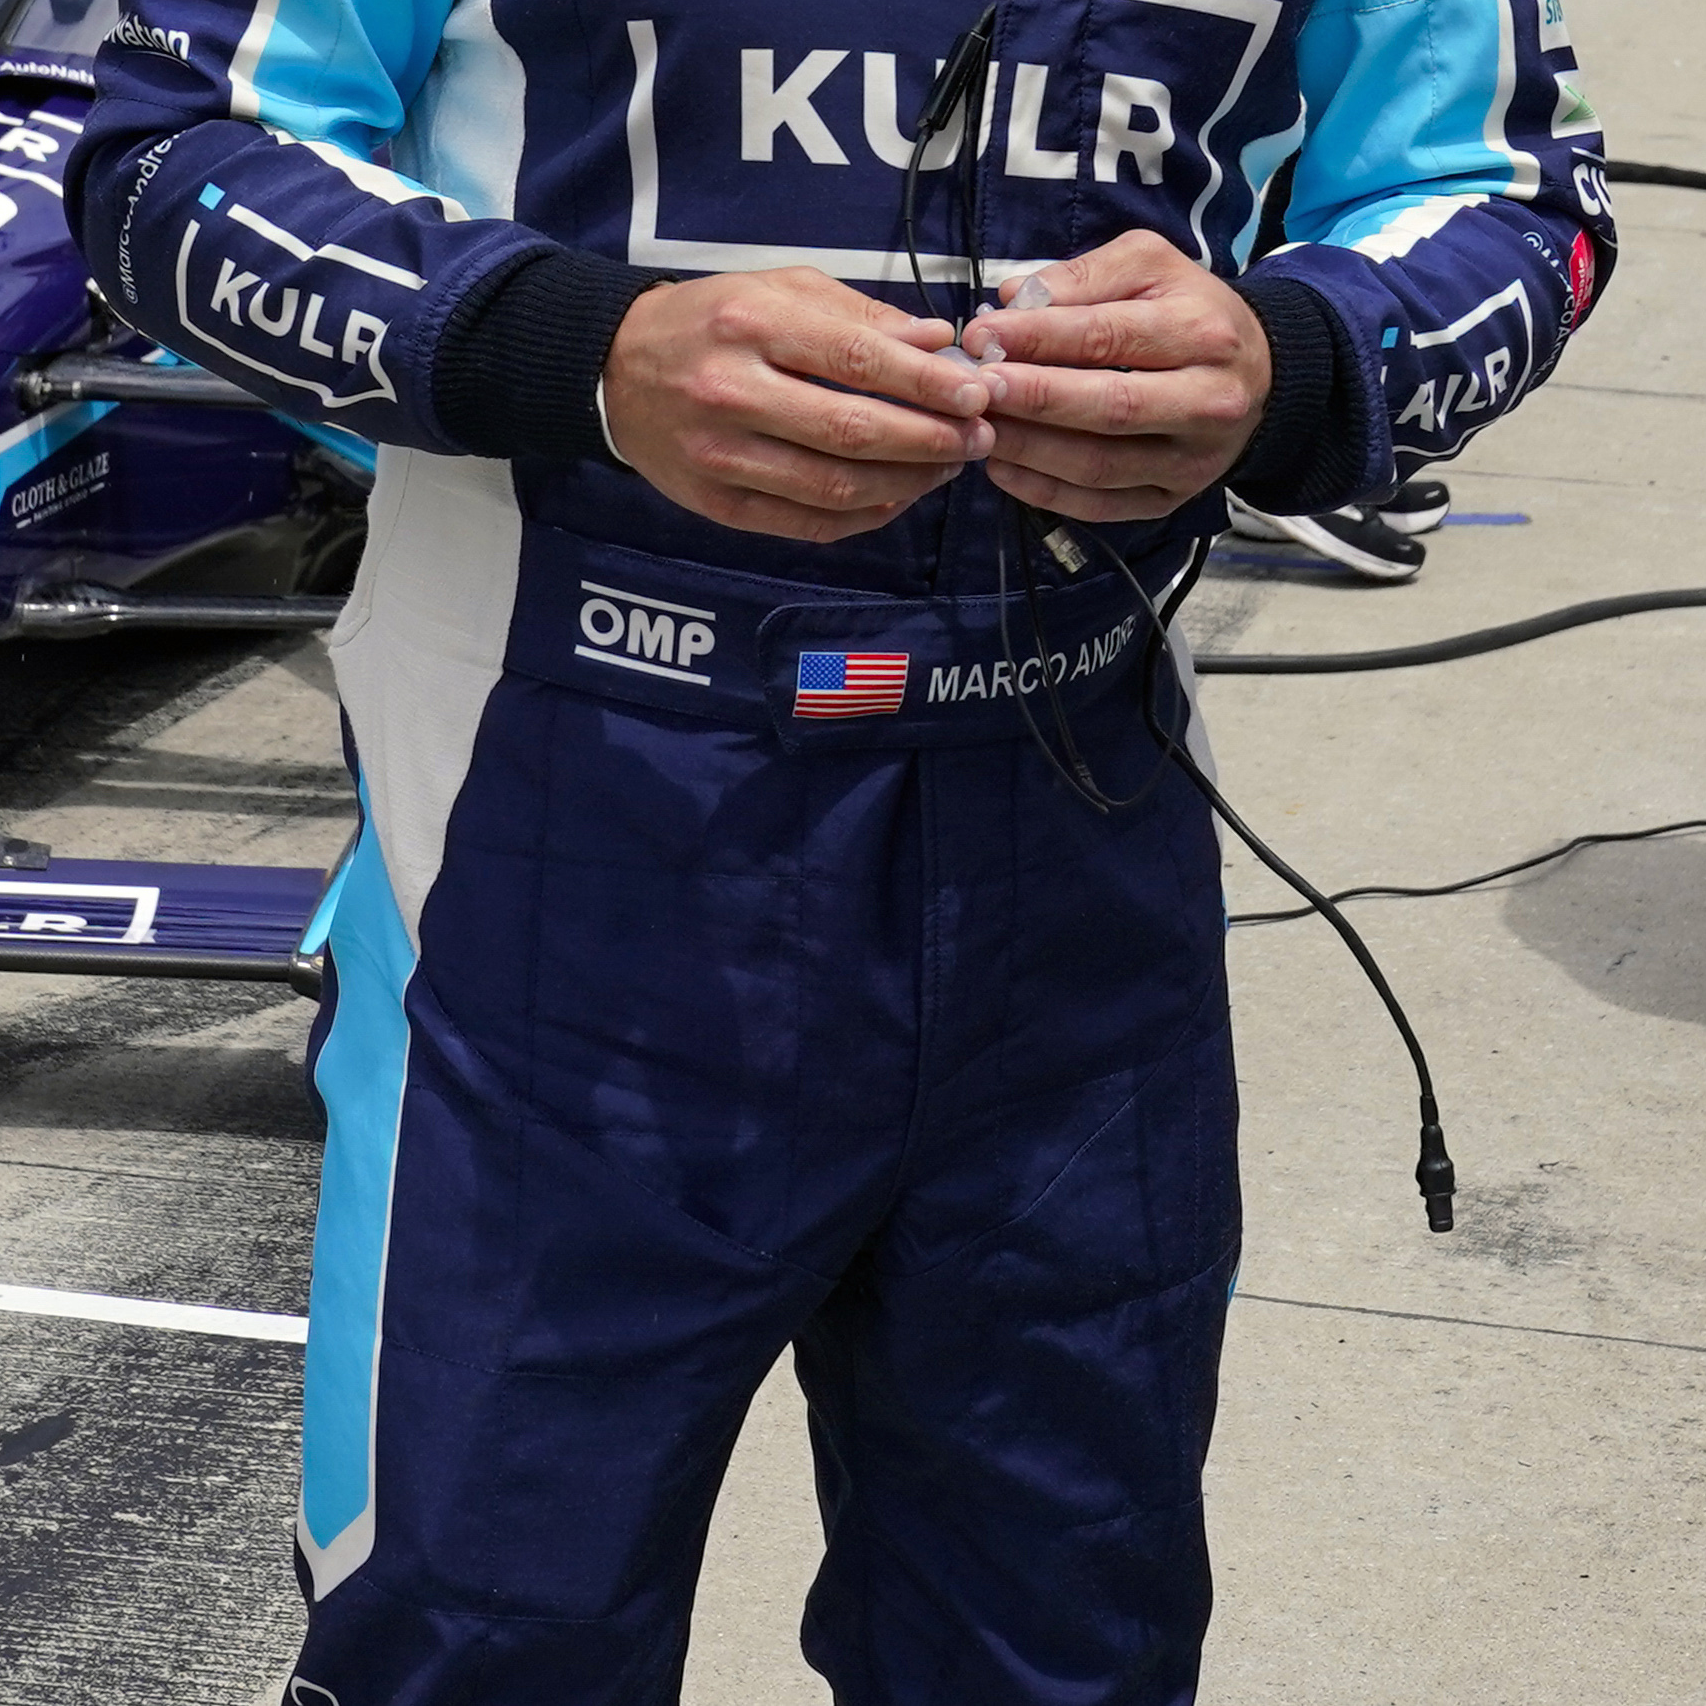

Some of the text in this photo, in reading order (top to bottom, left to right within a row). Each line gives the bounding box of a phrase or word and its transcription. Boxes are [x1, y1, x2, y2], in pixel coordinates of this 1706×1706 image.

[740, 47, 1175, 186] KULR
[210, 257, 392, 365] KULR
[12, 451, 111, 517] CLOTH & GLAZE
[579, 597, 716, 668] OMP
[927, 652, 1068, 703] MARCO
